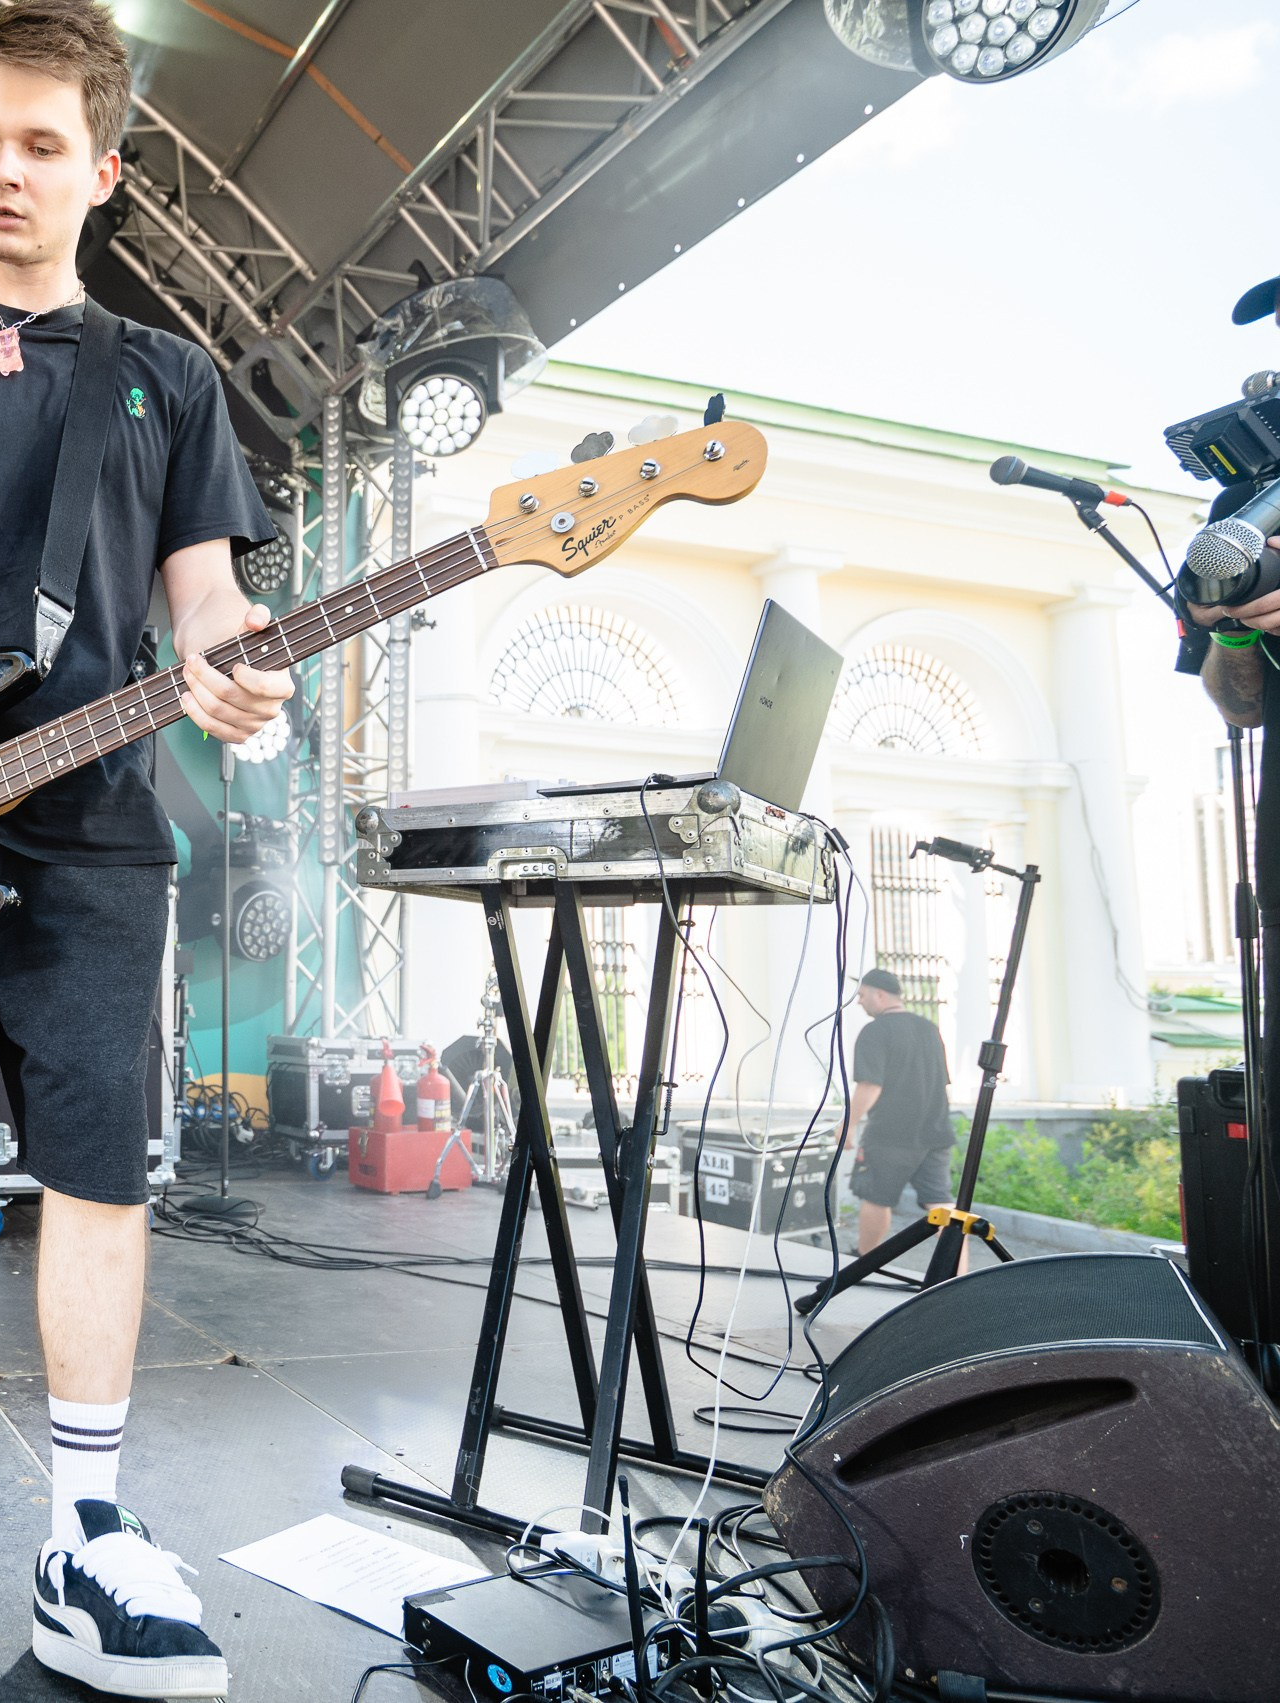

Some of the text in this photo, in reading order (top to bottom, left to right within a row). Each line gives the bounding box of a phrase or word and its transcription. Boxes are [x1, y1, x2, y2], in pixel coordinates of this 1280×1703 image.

[627, 496, 650, 514] BASS
[561, 518, 617, 562] Squier
[701, 1154, 729, 1171] XLR
[709, 1183, 727, 1198] 45
